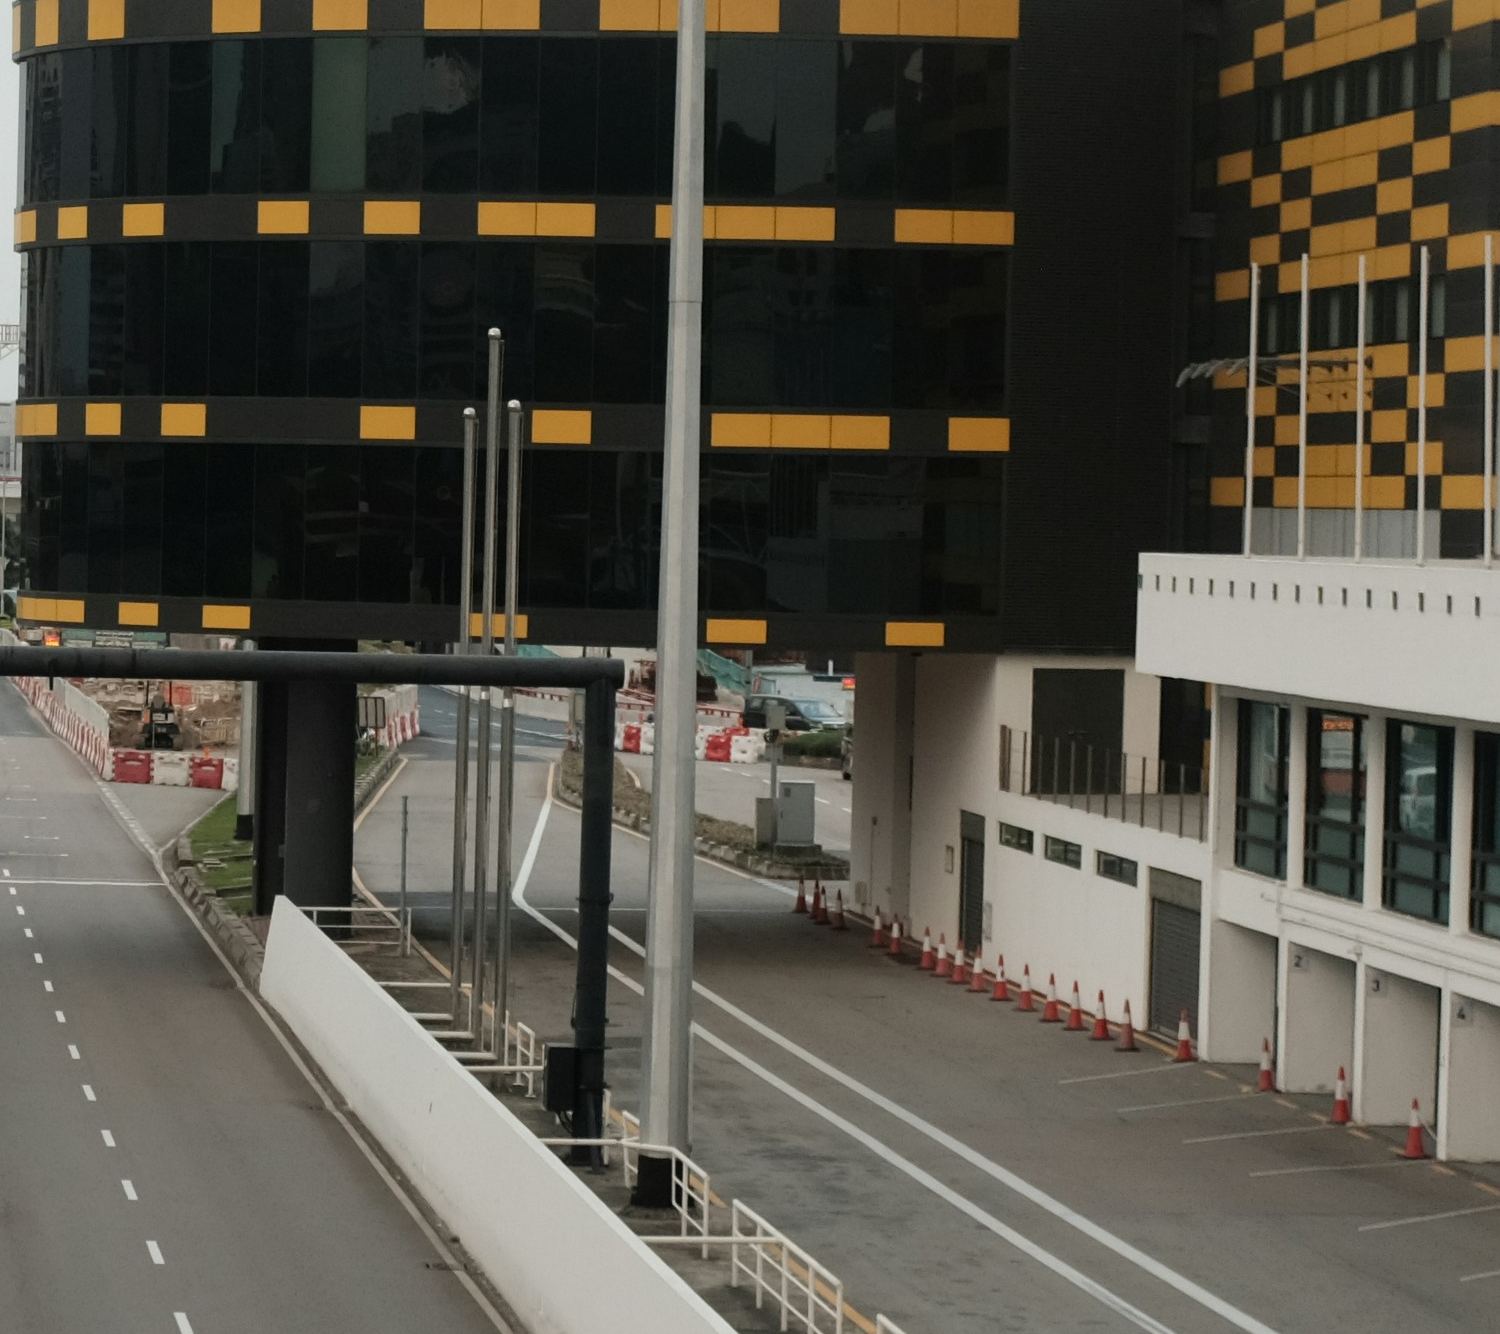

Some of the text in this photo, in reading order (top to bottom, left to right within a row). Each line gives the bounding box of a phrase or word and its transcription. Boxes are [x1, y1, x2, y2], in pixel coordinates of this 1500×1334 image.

[1293, 954, 1303, 969] 2
[1370, 978, 1381, 993] 3
[1456, 1006, 1467, 1021] 4
